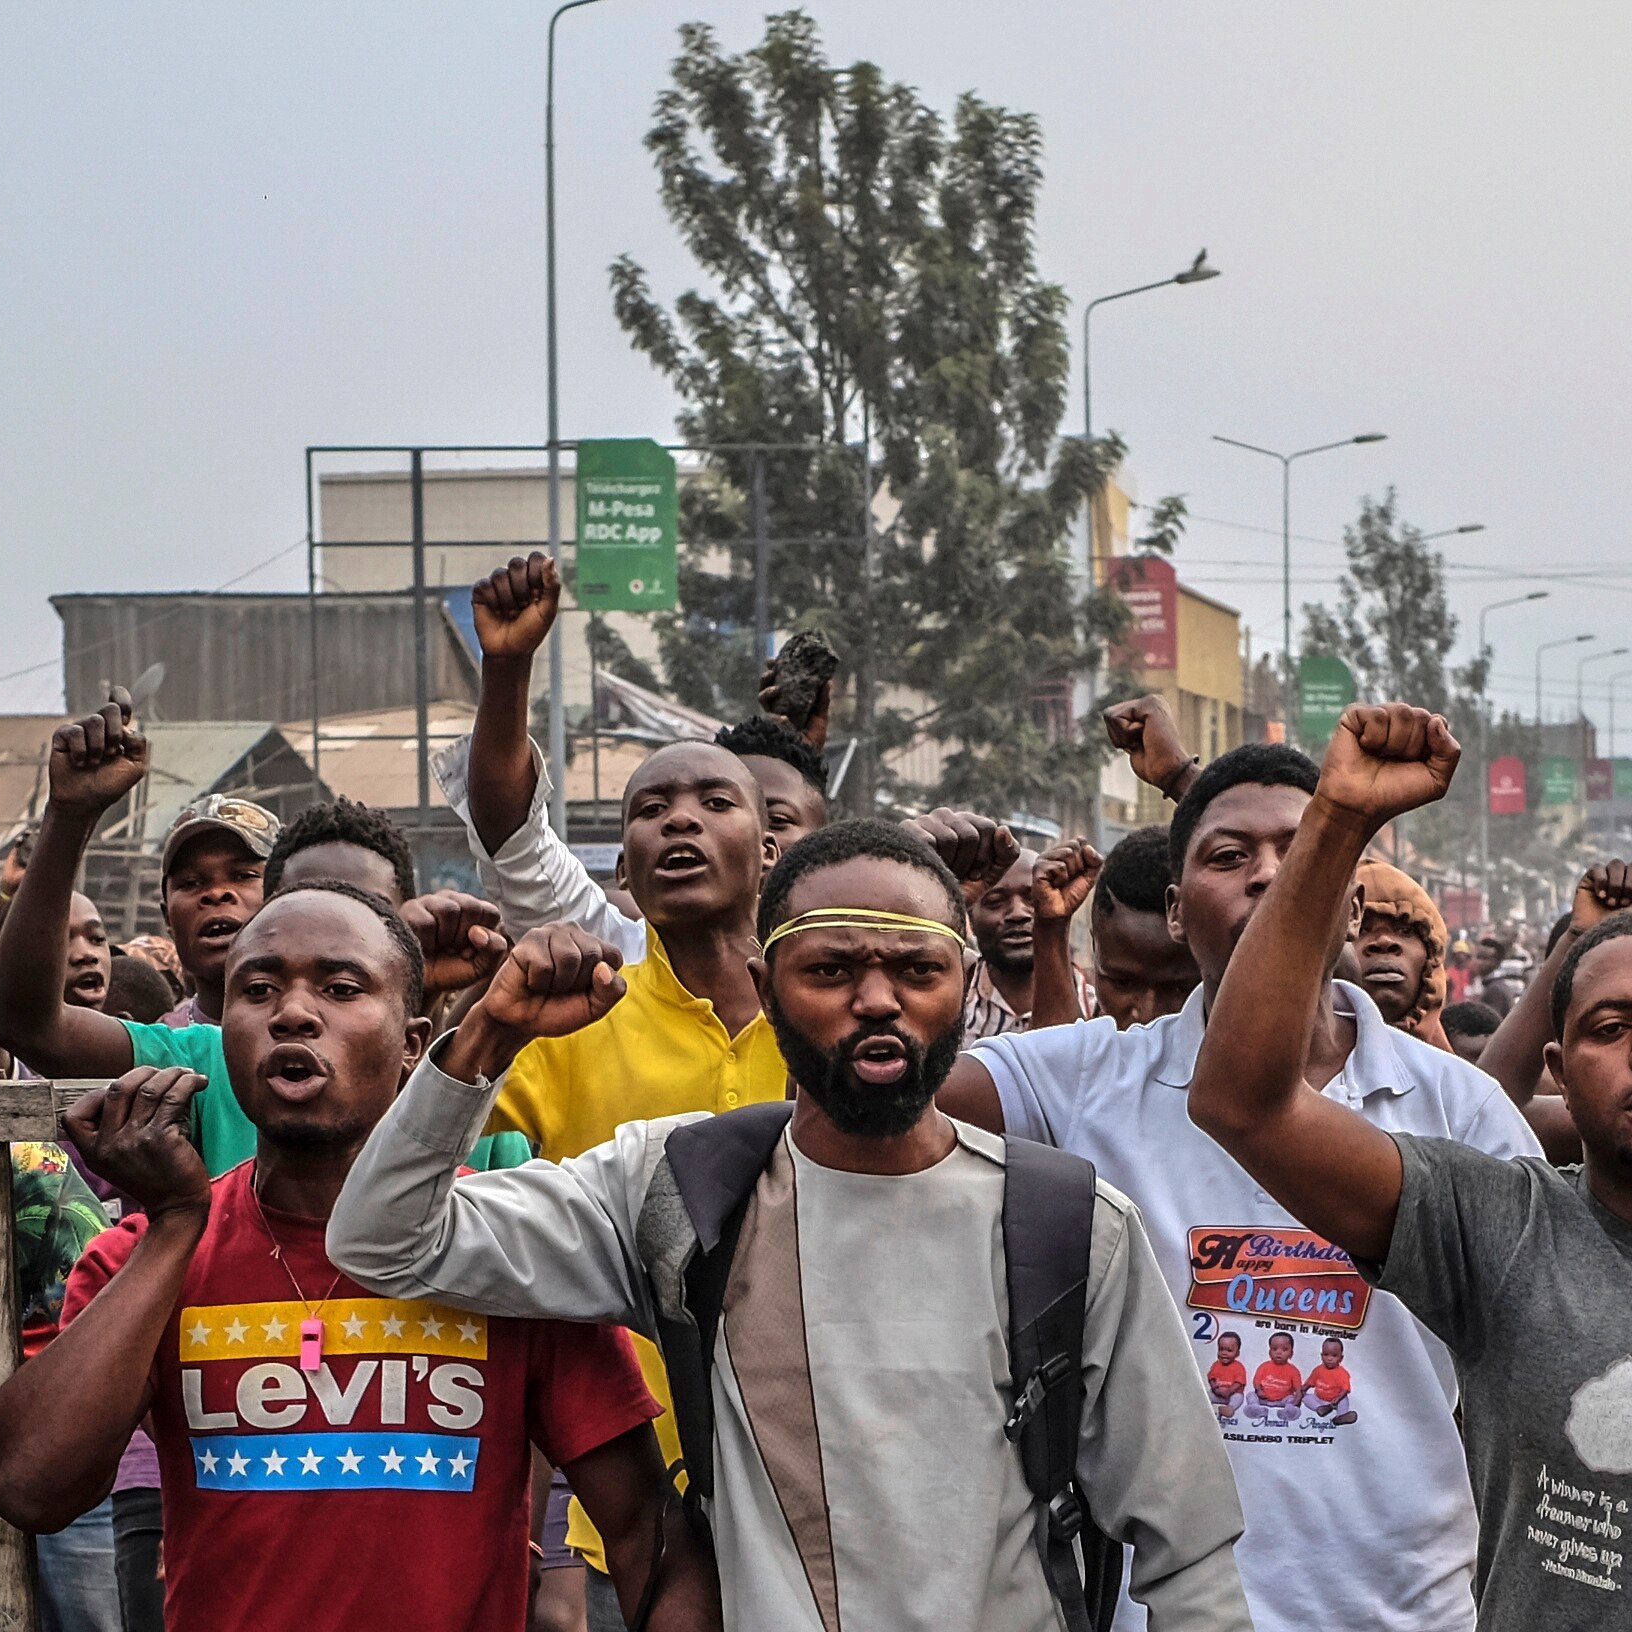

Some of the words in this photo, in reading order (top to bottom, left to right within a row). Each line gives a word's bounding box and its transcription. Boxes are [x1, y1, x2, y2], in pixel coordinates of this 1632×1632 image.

[587, 500, 655, 518] M-Pesa
[585, 523, 623, 541] RDC
[625, 523, 663, 544] App
[1226, 1272, 1355, 1315] Queens
[1274, 1320, 1297, 1332] born
[1299, 1323, 1309, 1334] in
[1536, 1463, 1550, 1491] A
[1551, 1478, 1596, 1507] winner
[1615, 1499, 1629, 1514] a
[1592, 1511, 1622, 1540] who
[1527, 1524, 1559, 1549] never
[1558, 1536, 1599, 1563] gives
[1599, 1549, 1624, 1576] up
